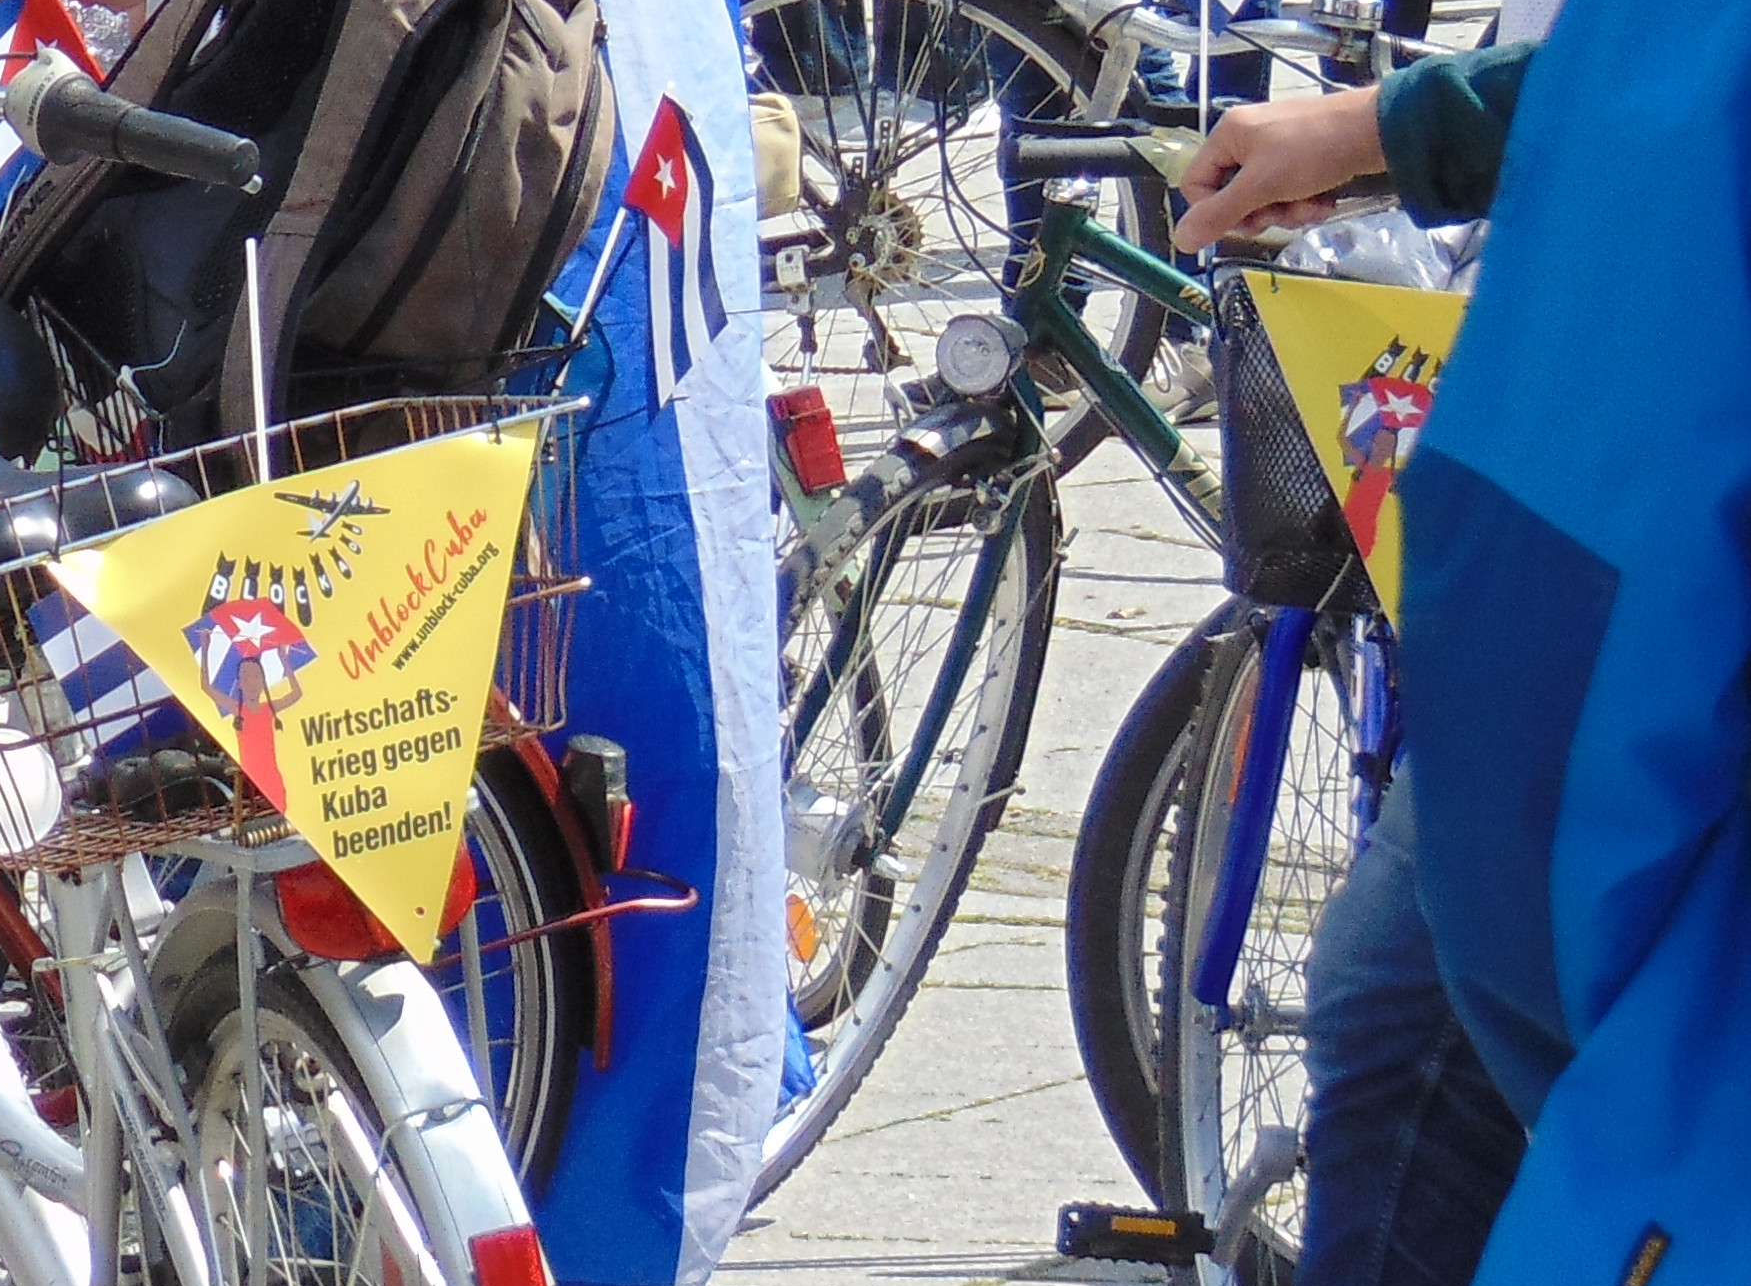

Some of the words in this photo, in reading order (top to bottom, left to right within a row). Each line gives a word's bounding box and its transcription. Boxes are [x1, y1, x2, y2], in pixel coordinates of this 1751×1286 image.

[339, 510, 487, 680] UnblockCuba
[392, 541, 500, 671] www.unblock-cuba.org
[301, 688, 458, 746] Wirtschafts-
[311, 749, 377, 785] krieg
[383, 726, 461, 771] gegen
[321, 784, 387, 822] Kuba
[332, 801, 452, 859] beenden!
